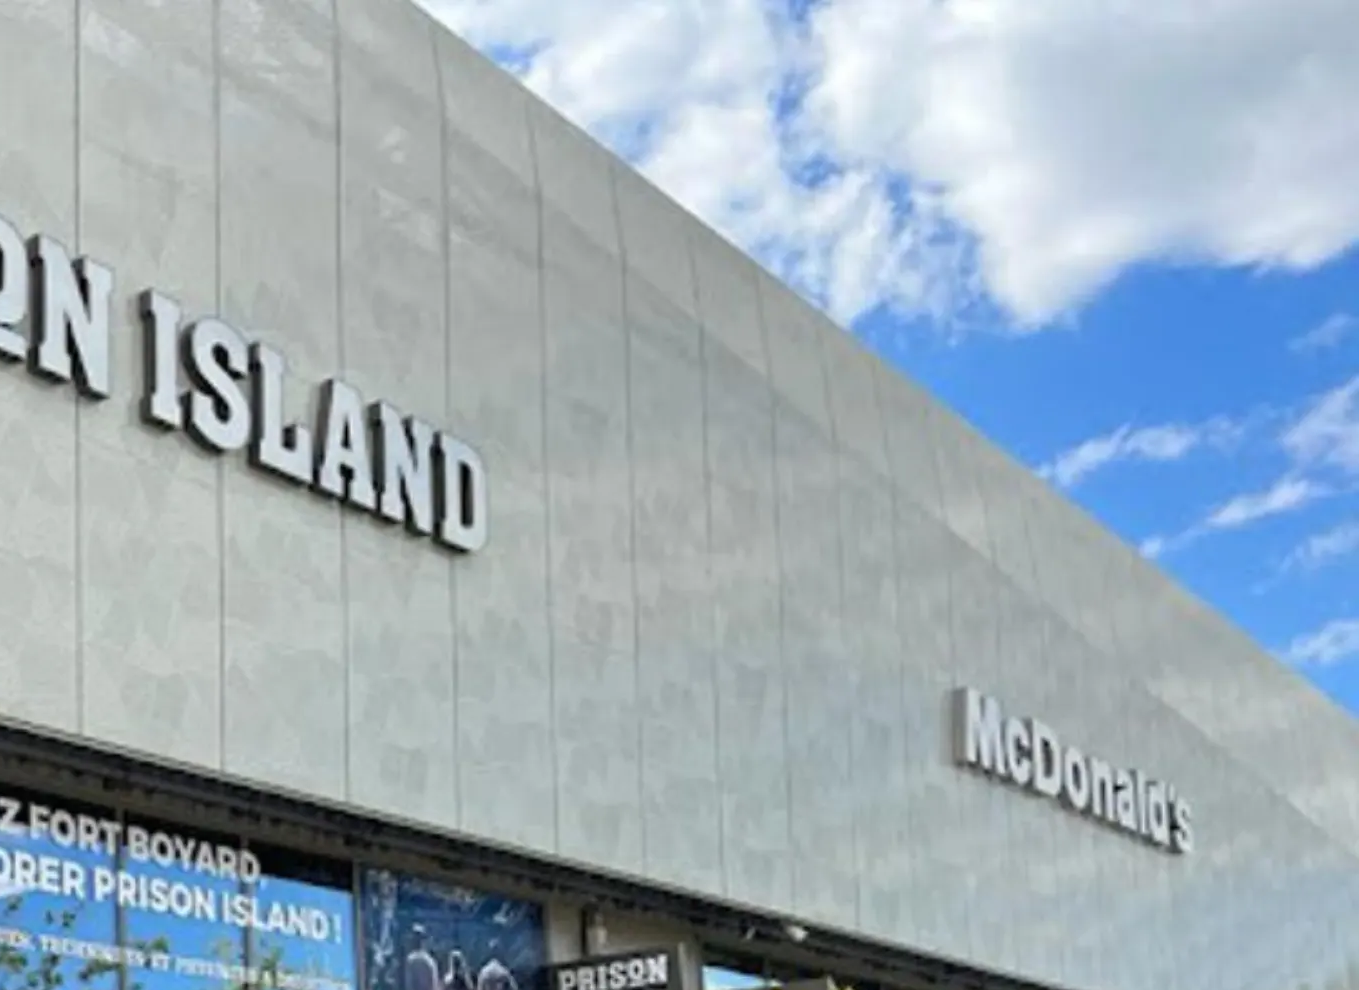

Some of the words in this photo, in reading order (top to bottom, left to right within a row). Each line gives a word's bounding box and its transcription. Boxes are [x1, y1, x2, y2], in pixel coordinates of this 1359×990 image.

[140, 287, 488, 555] ISLAND
[952, 686, 1194, 853] McDonald's
[29, 805, 122, 856] FORT
[94, 868, 218, 923] PRISON
[222, 896, 332, 942] ISLAND
